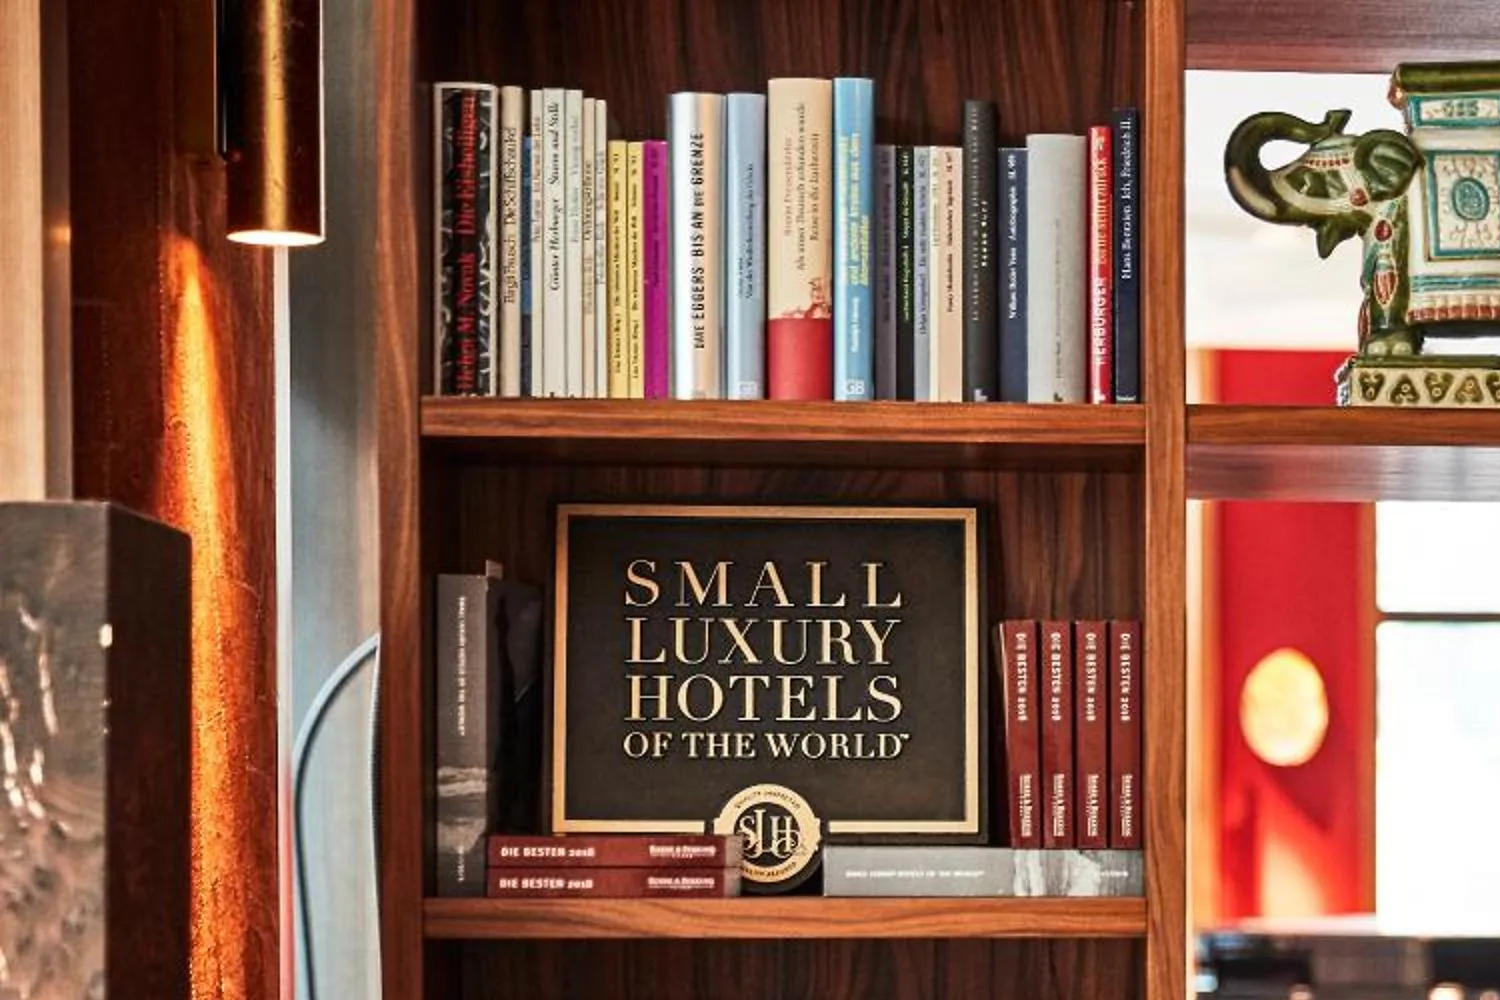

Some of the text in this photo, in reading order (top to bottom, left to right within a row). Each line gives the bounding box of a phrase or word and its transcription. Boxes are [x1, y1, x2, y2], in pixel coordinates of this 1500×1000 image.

[690, 133, 705, 185] GRENZE
[690, 211, 705, 229] AN
[690, 234, 705, 256] BIS
[690, 267, 705, 319] EGGERS
[626, 559, 902, 608] SMALL
[625, 617, 902, 666] LUXURY
[1016, 654, 1027, 694] BESTEN
[1051, 654, 1061, 694] BESTEN
[1086, 654, 1096, 694] BESTEN
[1120, 654, 1131, 694] BESTEN
[625, 674, 902, 723] HOTELS
[623, 732, 671, 760] OF
[682, 732, 756, 760] THE
[501, 848, 520, 857] DIE
[524, 848, 565, 857] BESTEN
[500, 879, 518, 888] DIE
[522, 879, 564, 888] BESTEN
